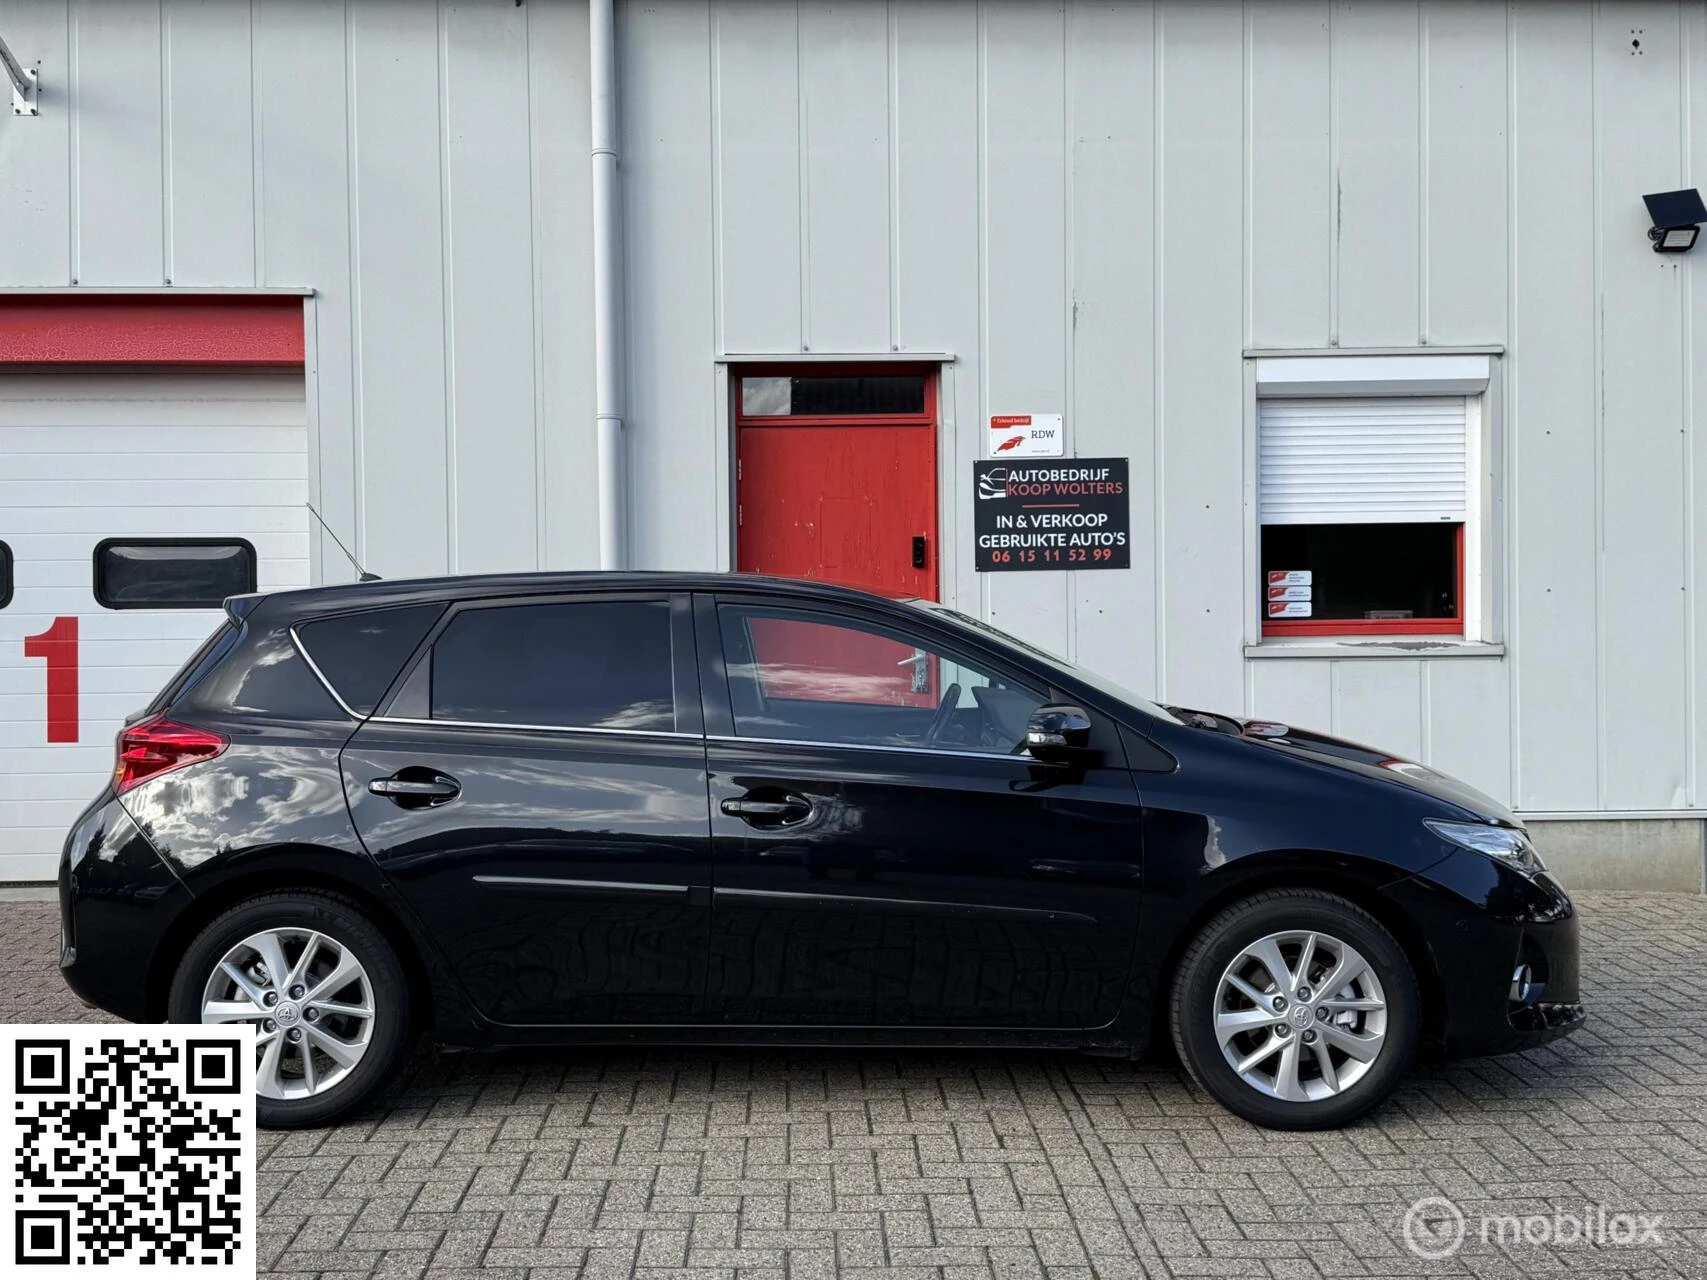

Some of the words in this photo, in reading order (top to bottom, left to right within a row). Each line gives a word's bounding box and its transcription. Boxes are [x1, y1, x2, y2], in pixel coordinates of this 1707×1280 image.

[1031, 430, 1055, 439] RDW
[1008, 468, 1110, 482] AUTOBEDRIJF
[1008, 483, 1051, 496] KOOP
[1054, 482, 1124, 495] WOLTERS
[996, 515, 1013, 529] IN
[1016, 515, 1028, 528] &
[1030, 513, 1108, 528] VERKOOP
[979, 533, 1067, 548] GEBRUIKTE
[1069, 532, 1126, 546] AUTO'S
[992, 550, 1011, 562] 06
[1019, 549, 1036, 562] 15
[1044, 549, 1060, 561] 11
[1069, 549, 1087, 561] 52
[1093, 548, 1112, 561] 99
[24, 616, 80, 743] 1
